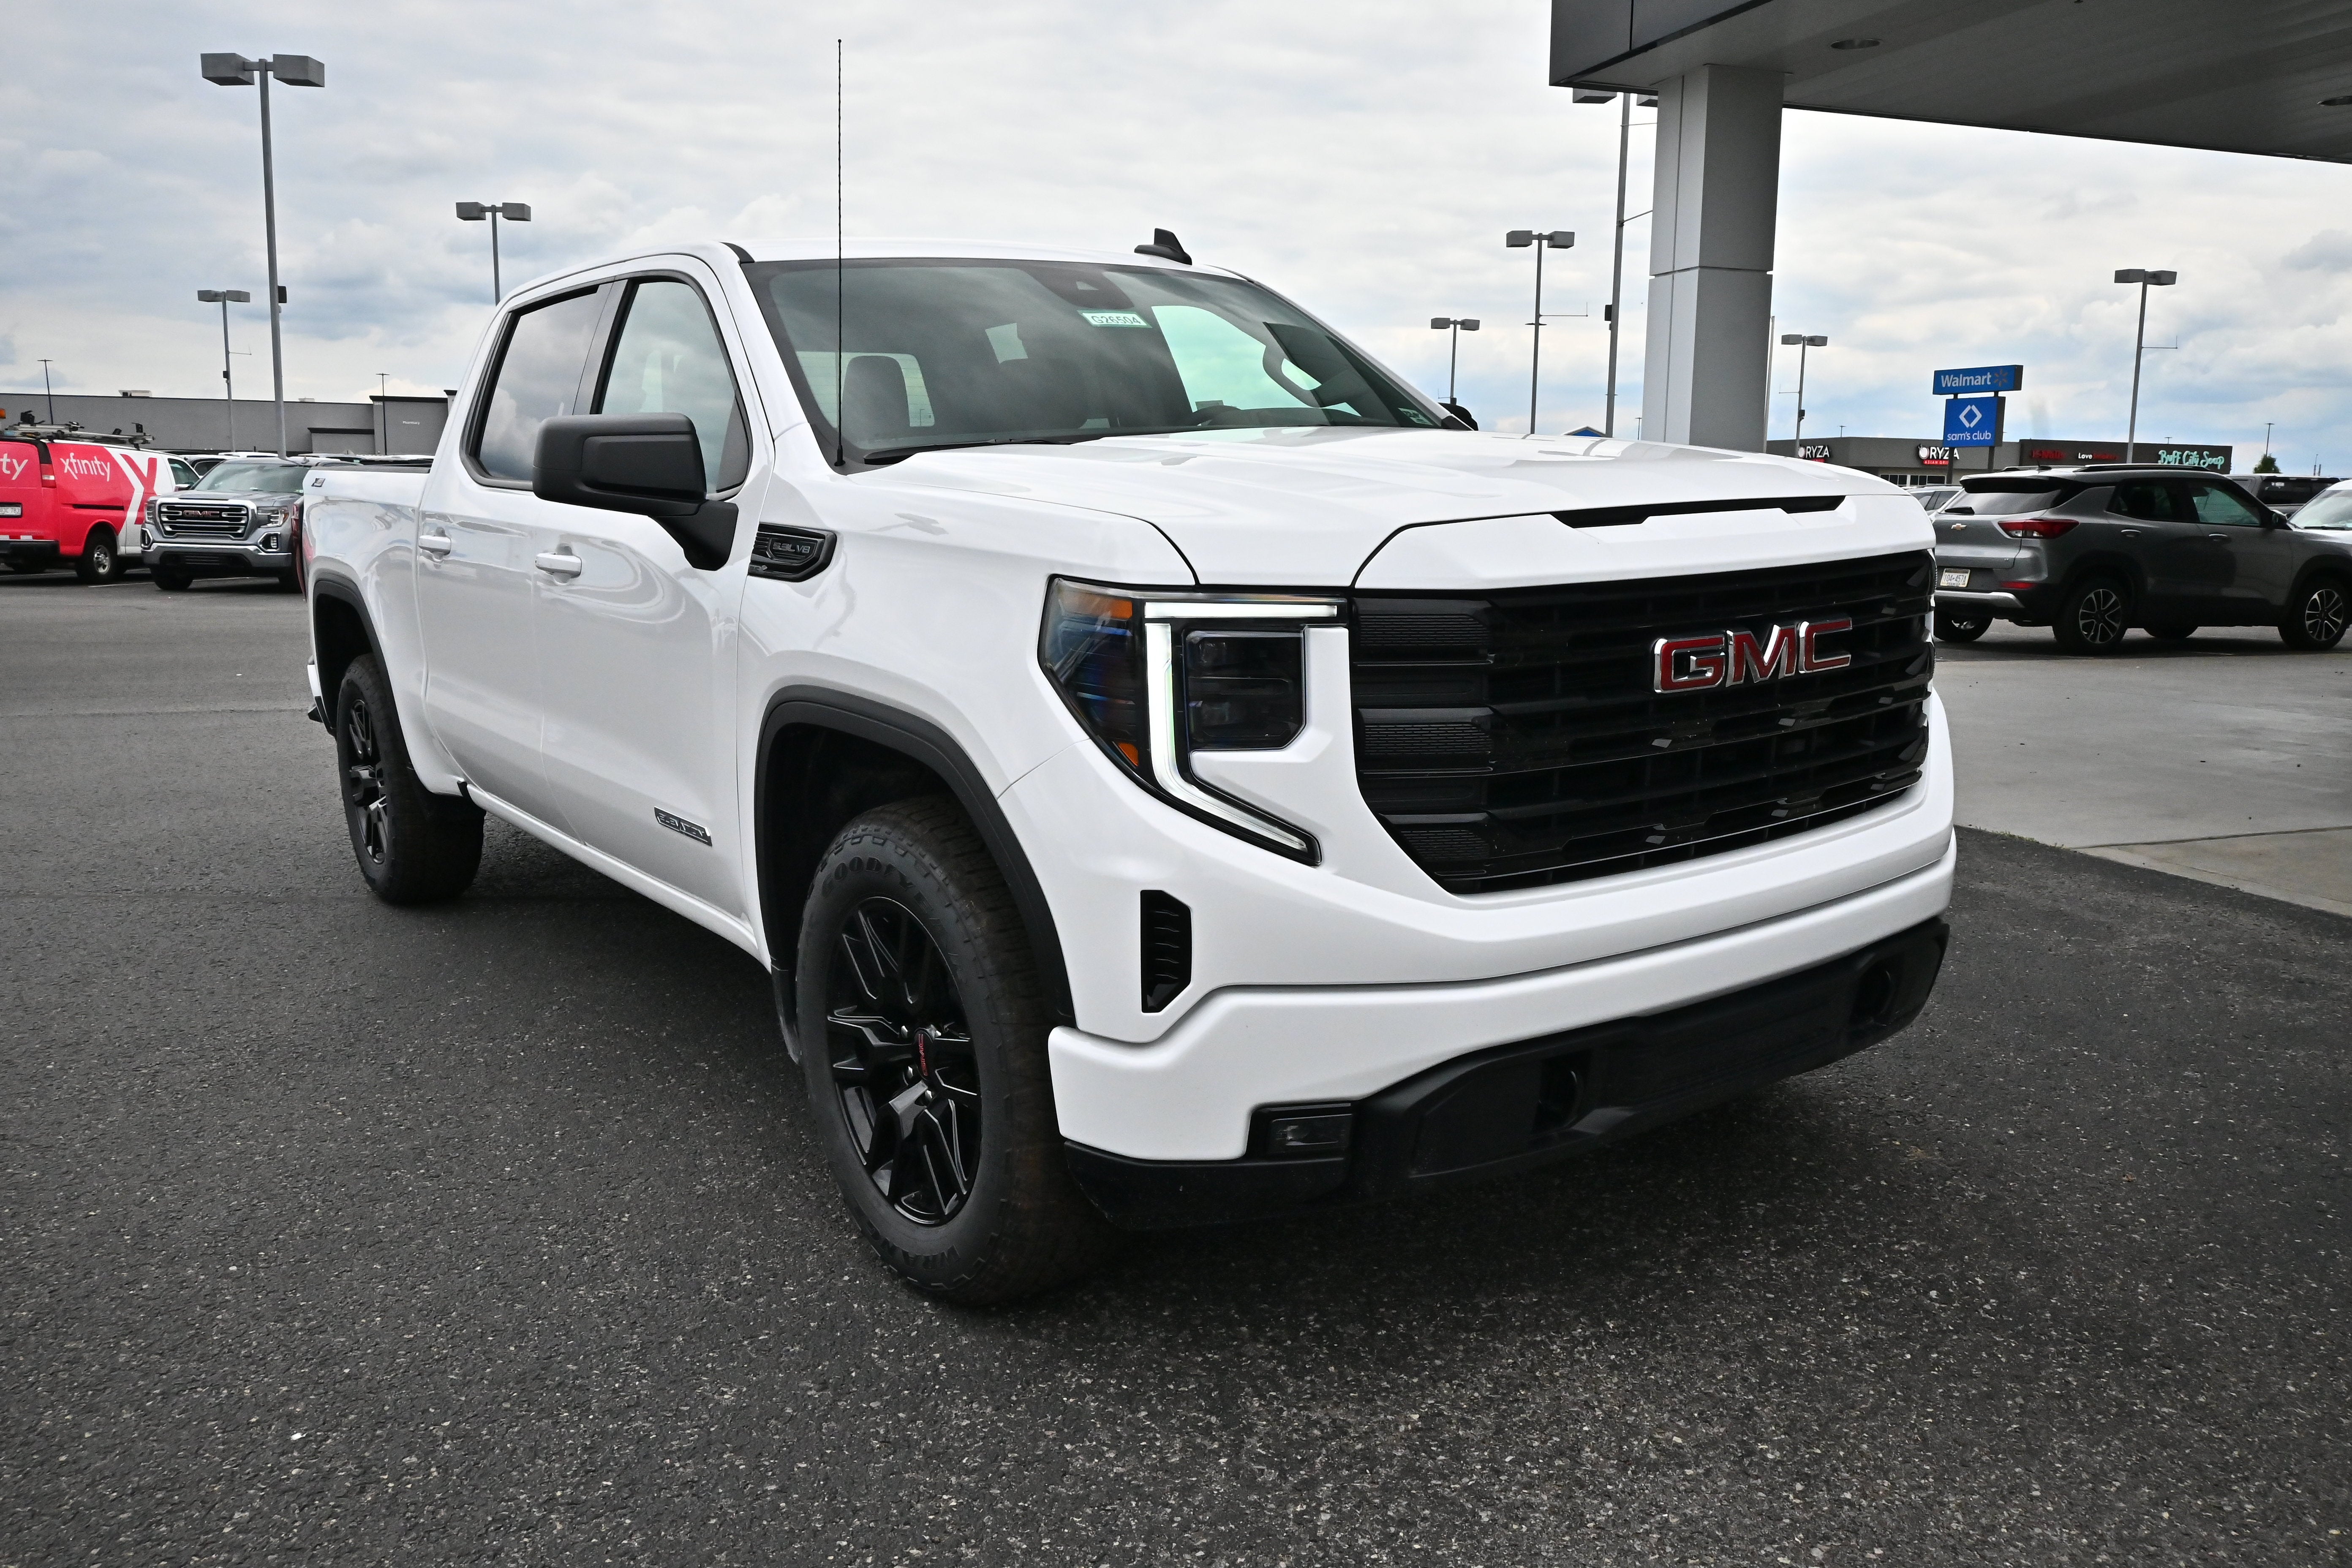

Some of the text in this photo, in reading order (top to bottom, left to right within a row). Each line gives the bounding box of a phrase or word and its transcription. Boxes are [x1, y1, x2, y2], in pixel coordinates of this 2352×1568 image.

[1091, 316, 1141, 324] G26504
[1941, 372, 1992, 387] Walmart
[1946, 430, 1992, 441] sam's club
[60, 452, 110, 482] xfinity
[2158, 449, 2225, 470] Buff City Soap
[183, 510, 220, 518] GMC
[796, 544, 811, 554] V8
[1653, 617, 1853, 694] GMC
[918, 1033, 928, 1076] GMC
